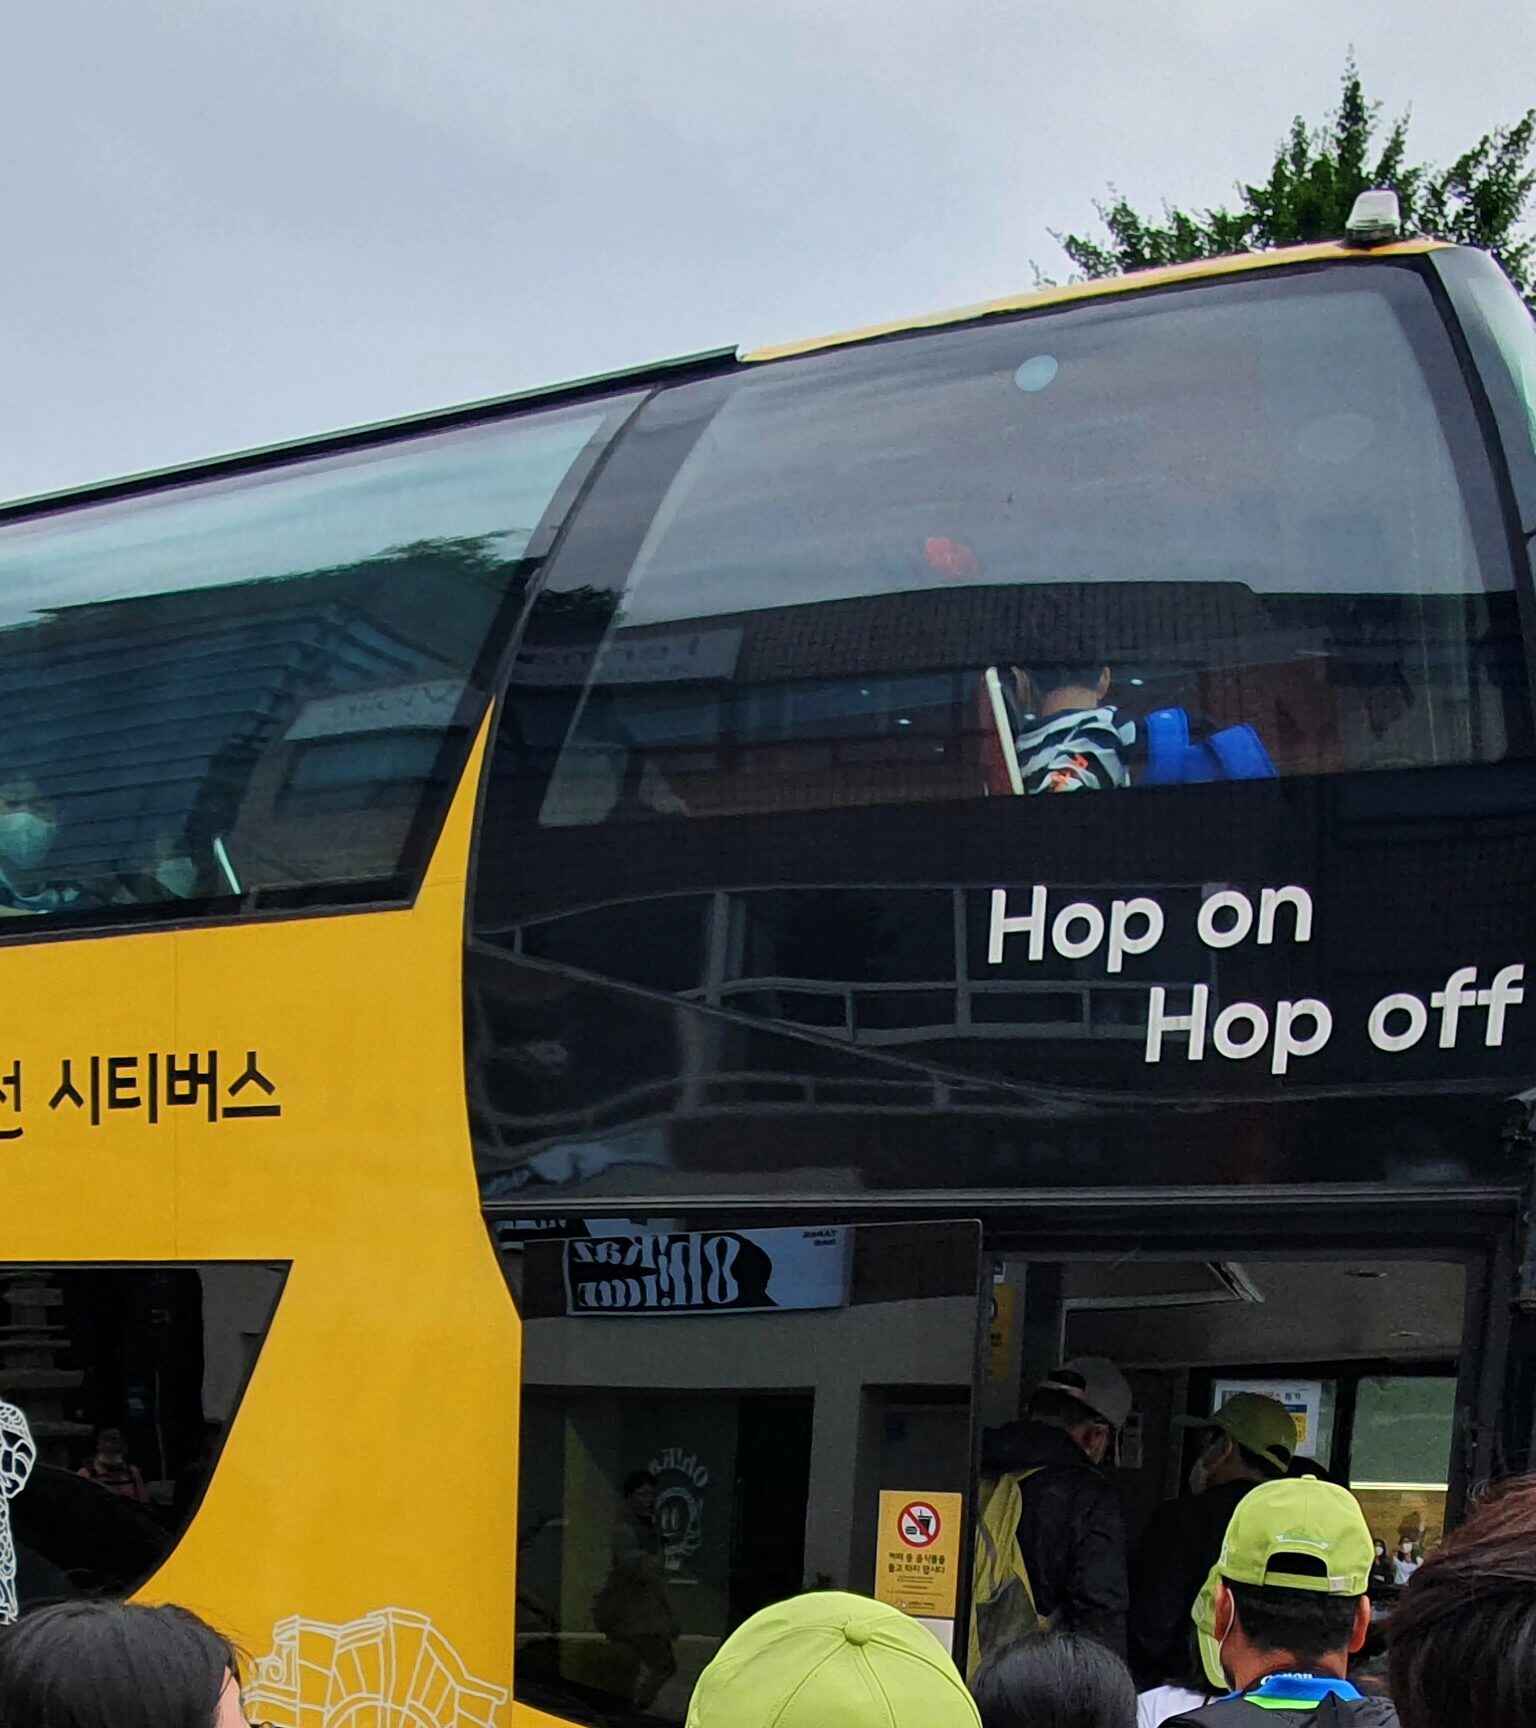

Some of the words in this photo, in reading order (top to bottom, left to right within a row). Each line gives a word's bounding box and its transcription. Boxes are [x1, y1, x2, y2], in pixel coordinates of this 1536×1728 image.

[988, 885, 1164, 973] Hop
[1197, 885, 1313, 948] on
[1145, 983, 1333, 1075] Hop
[1368, 964, 1524, 1052] off
[48, 1050, 282, 1126] 시티버스
[1260, 1672, 1313, 1686] Cnon
